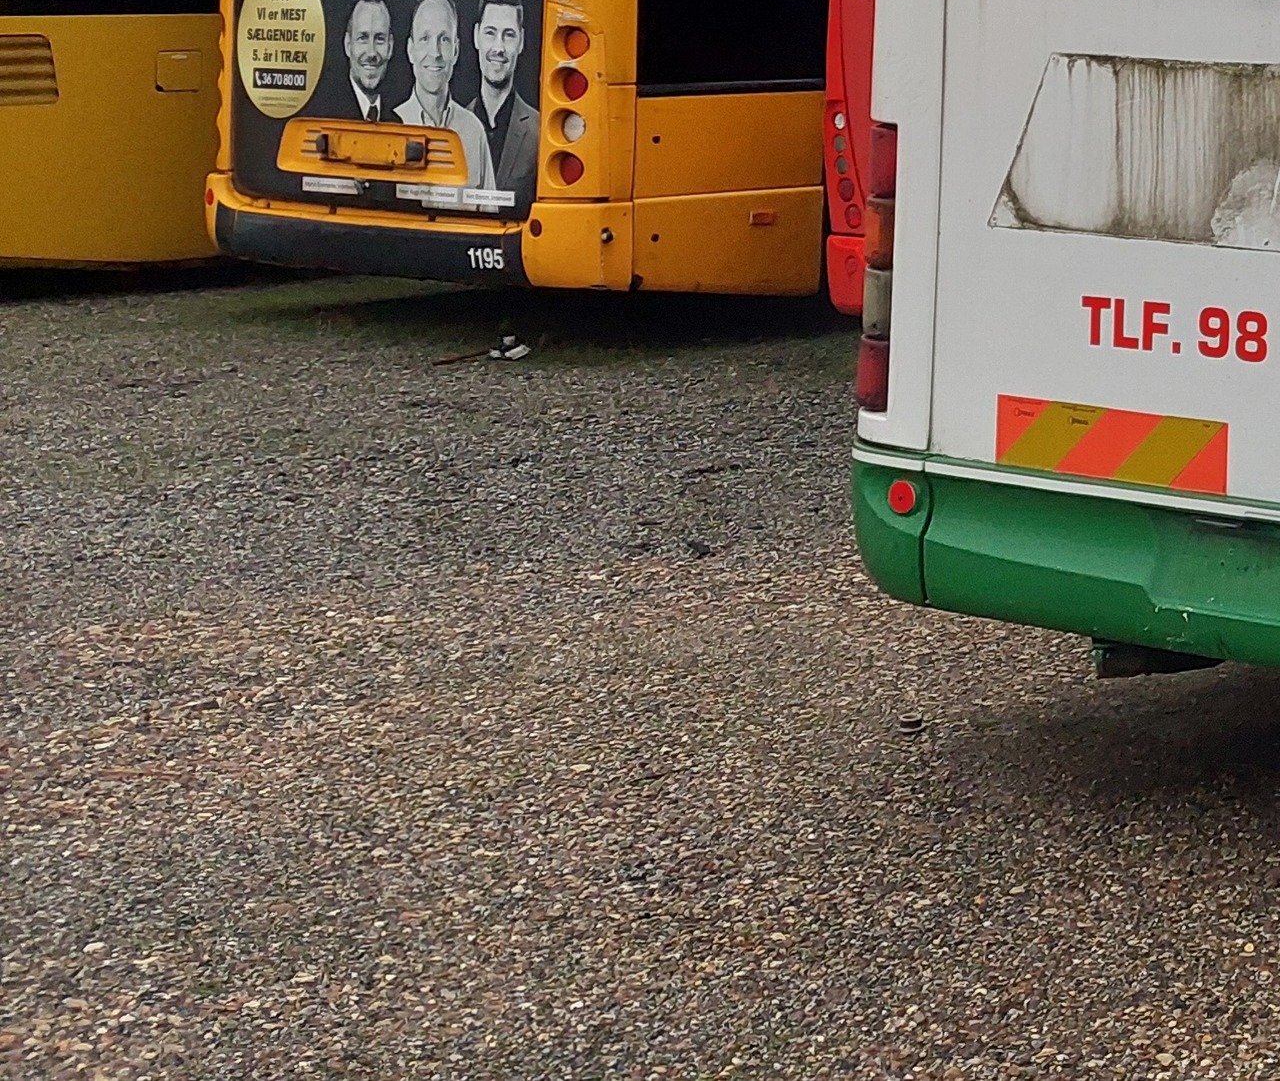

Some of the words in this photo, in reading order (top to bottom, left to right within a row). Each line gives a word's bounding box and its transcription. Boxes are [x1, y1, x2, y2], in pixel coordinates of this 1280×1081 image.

[268, 10, 279, 21] er
[280, 8, 307, 22] MEST
[246, 28, 299, 42] SÆLGENDE
[301, 29, 316, 43] for
[252, 49, 261, 61] 5.
[263, 48, 273, 62] år
[280, 50, 308, 64] TRÆK
[467, 247, 505, 270] 1195
[1081, 295, 1182, 355] TLF.
[1197, 306, 1268, 363] 98
